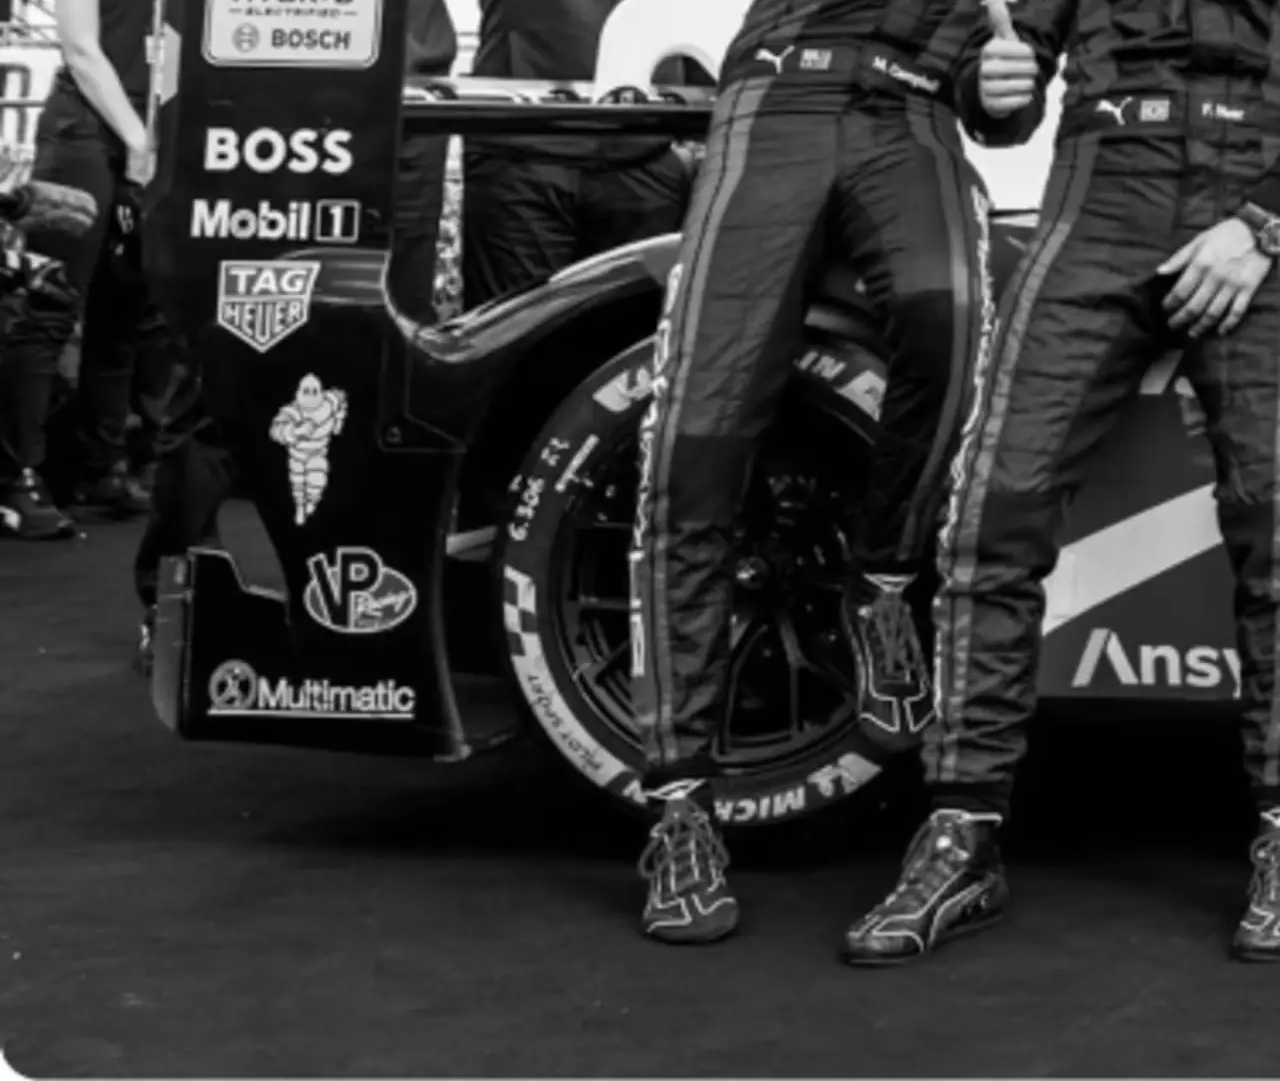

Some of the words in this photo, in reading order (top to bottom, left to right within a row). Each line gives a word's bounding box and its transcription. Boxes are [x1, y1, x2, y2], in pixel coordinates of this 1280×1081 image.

[270, 28, 352, 51] BOSCH
[204, 126, 354, 174] BOSS
[190, 198, 312, 241] Mobil
[228, 269, 308, 295] TAG
[223, 300, 301, 343] HEUER
[1072, 627, 1242, 699] Ansy
[257, 676, 416, 712] Multimatic
